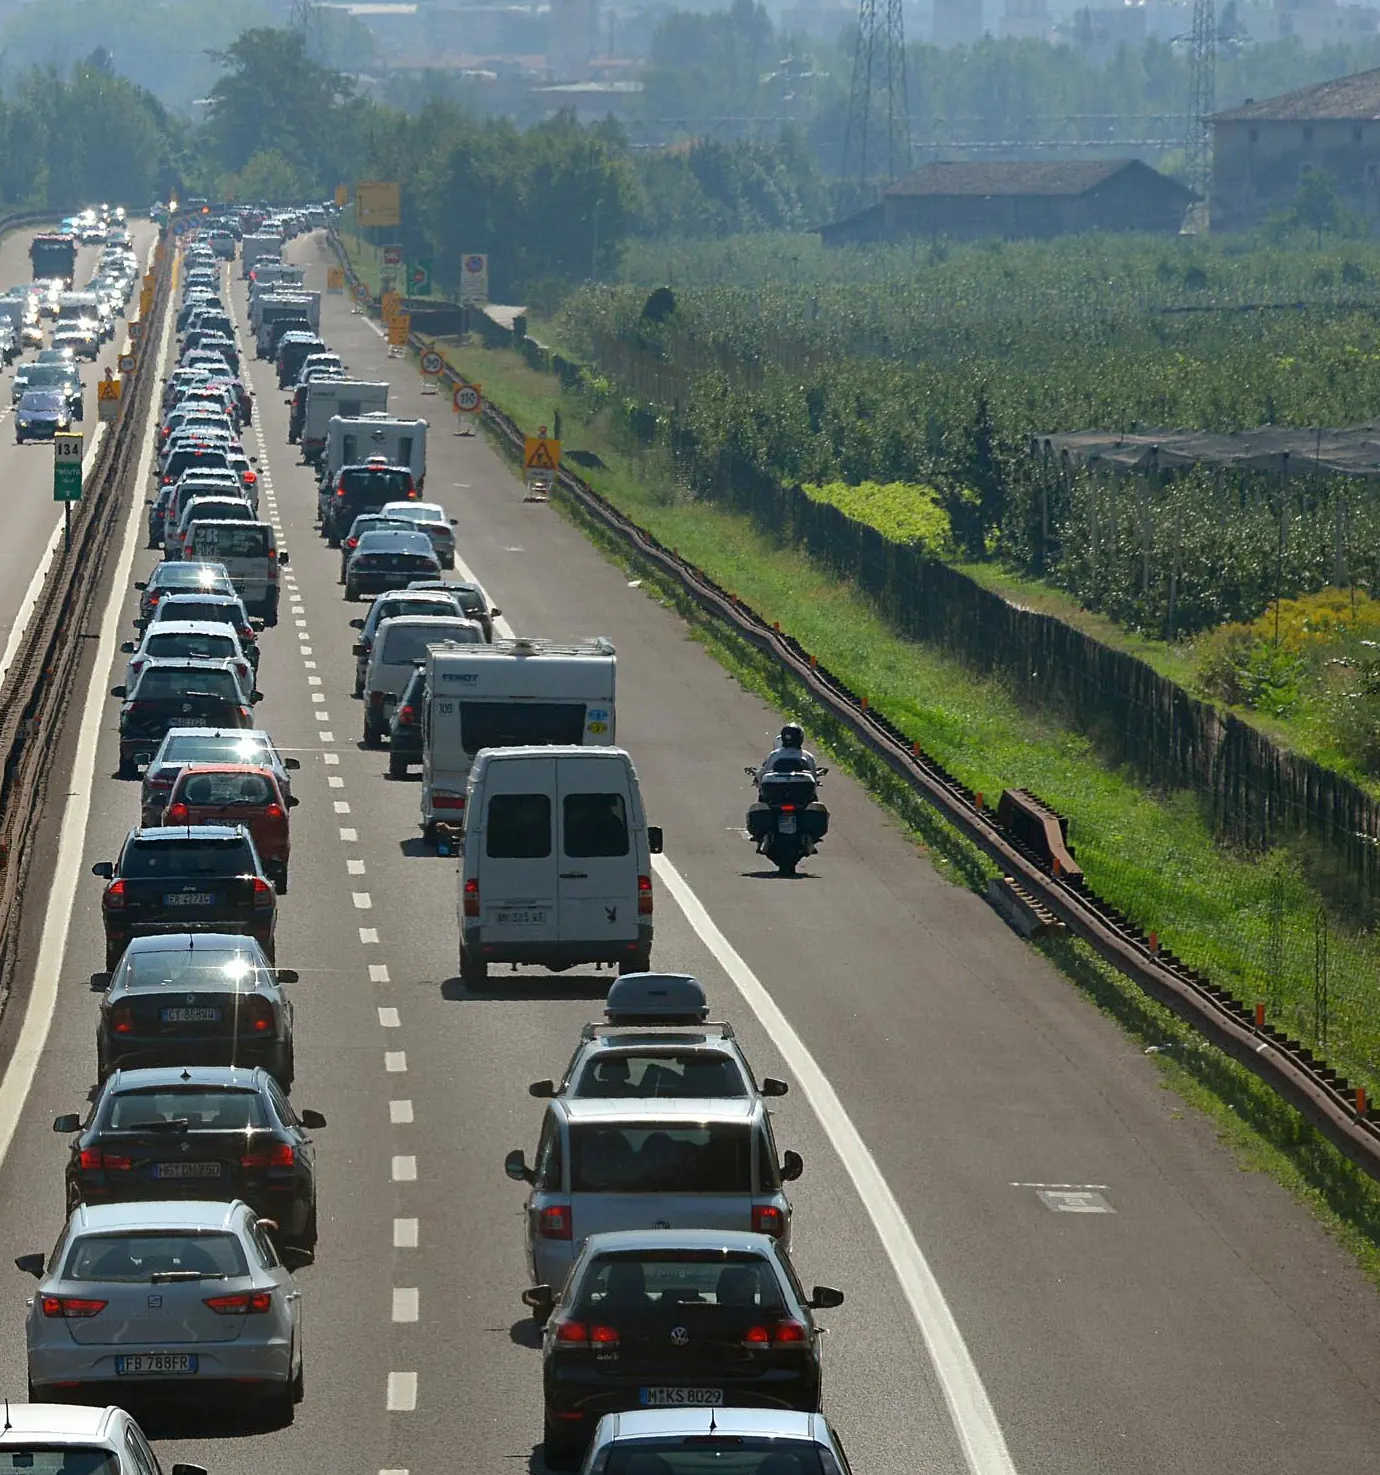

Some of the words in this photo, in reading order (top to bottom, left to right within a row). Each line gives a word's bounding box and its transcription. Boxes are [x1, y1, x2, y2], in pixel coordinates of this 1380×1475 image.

[57, 443, 79, 456] 134
[125, 1356, 142, 1370] FB
[147, 1356, 188, 1370] 788FR
[687, 1389, 721, 1404] 8029
